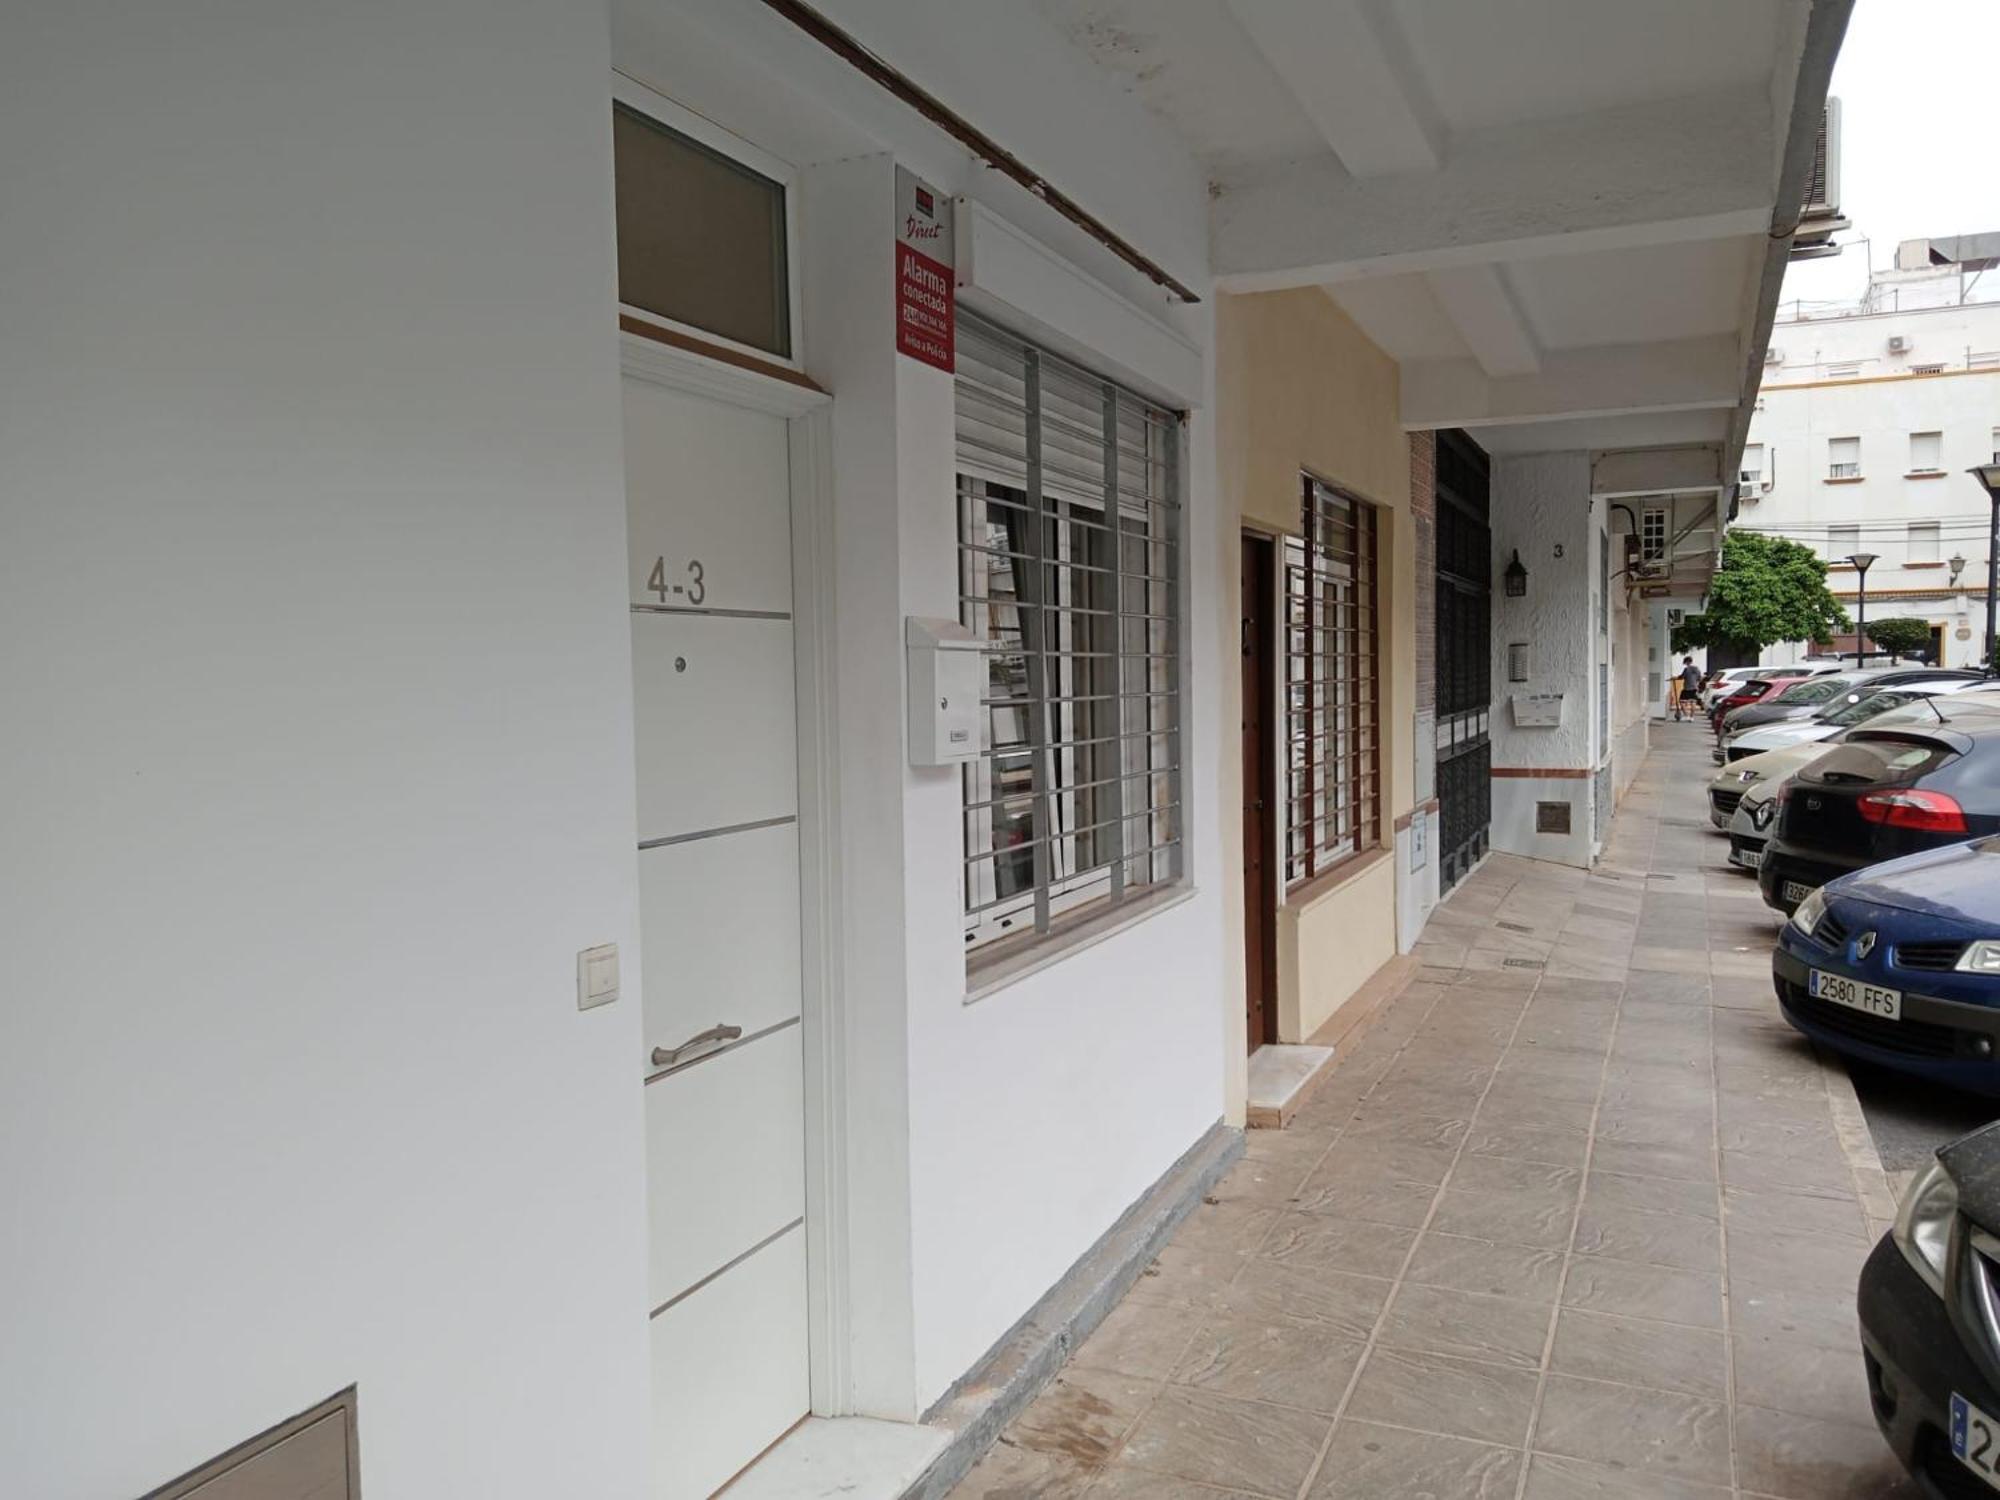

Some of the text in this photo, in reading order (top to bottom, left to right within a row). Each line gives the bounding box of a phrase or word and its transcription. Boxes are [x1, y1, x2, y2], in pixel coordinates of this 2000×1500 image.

[903, 255, 946, 295] Alarma
[903, 283, 946, 314] conectada
[1553, 544, 1564, 558] 3
[648, 555, 705, 605] 4-3
[1820, 975, 1894, 1014] 2580 FFS
[1971, 1419, 2000, 1475] 2
